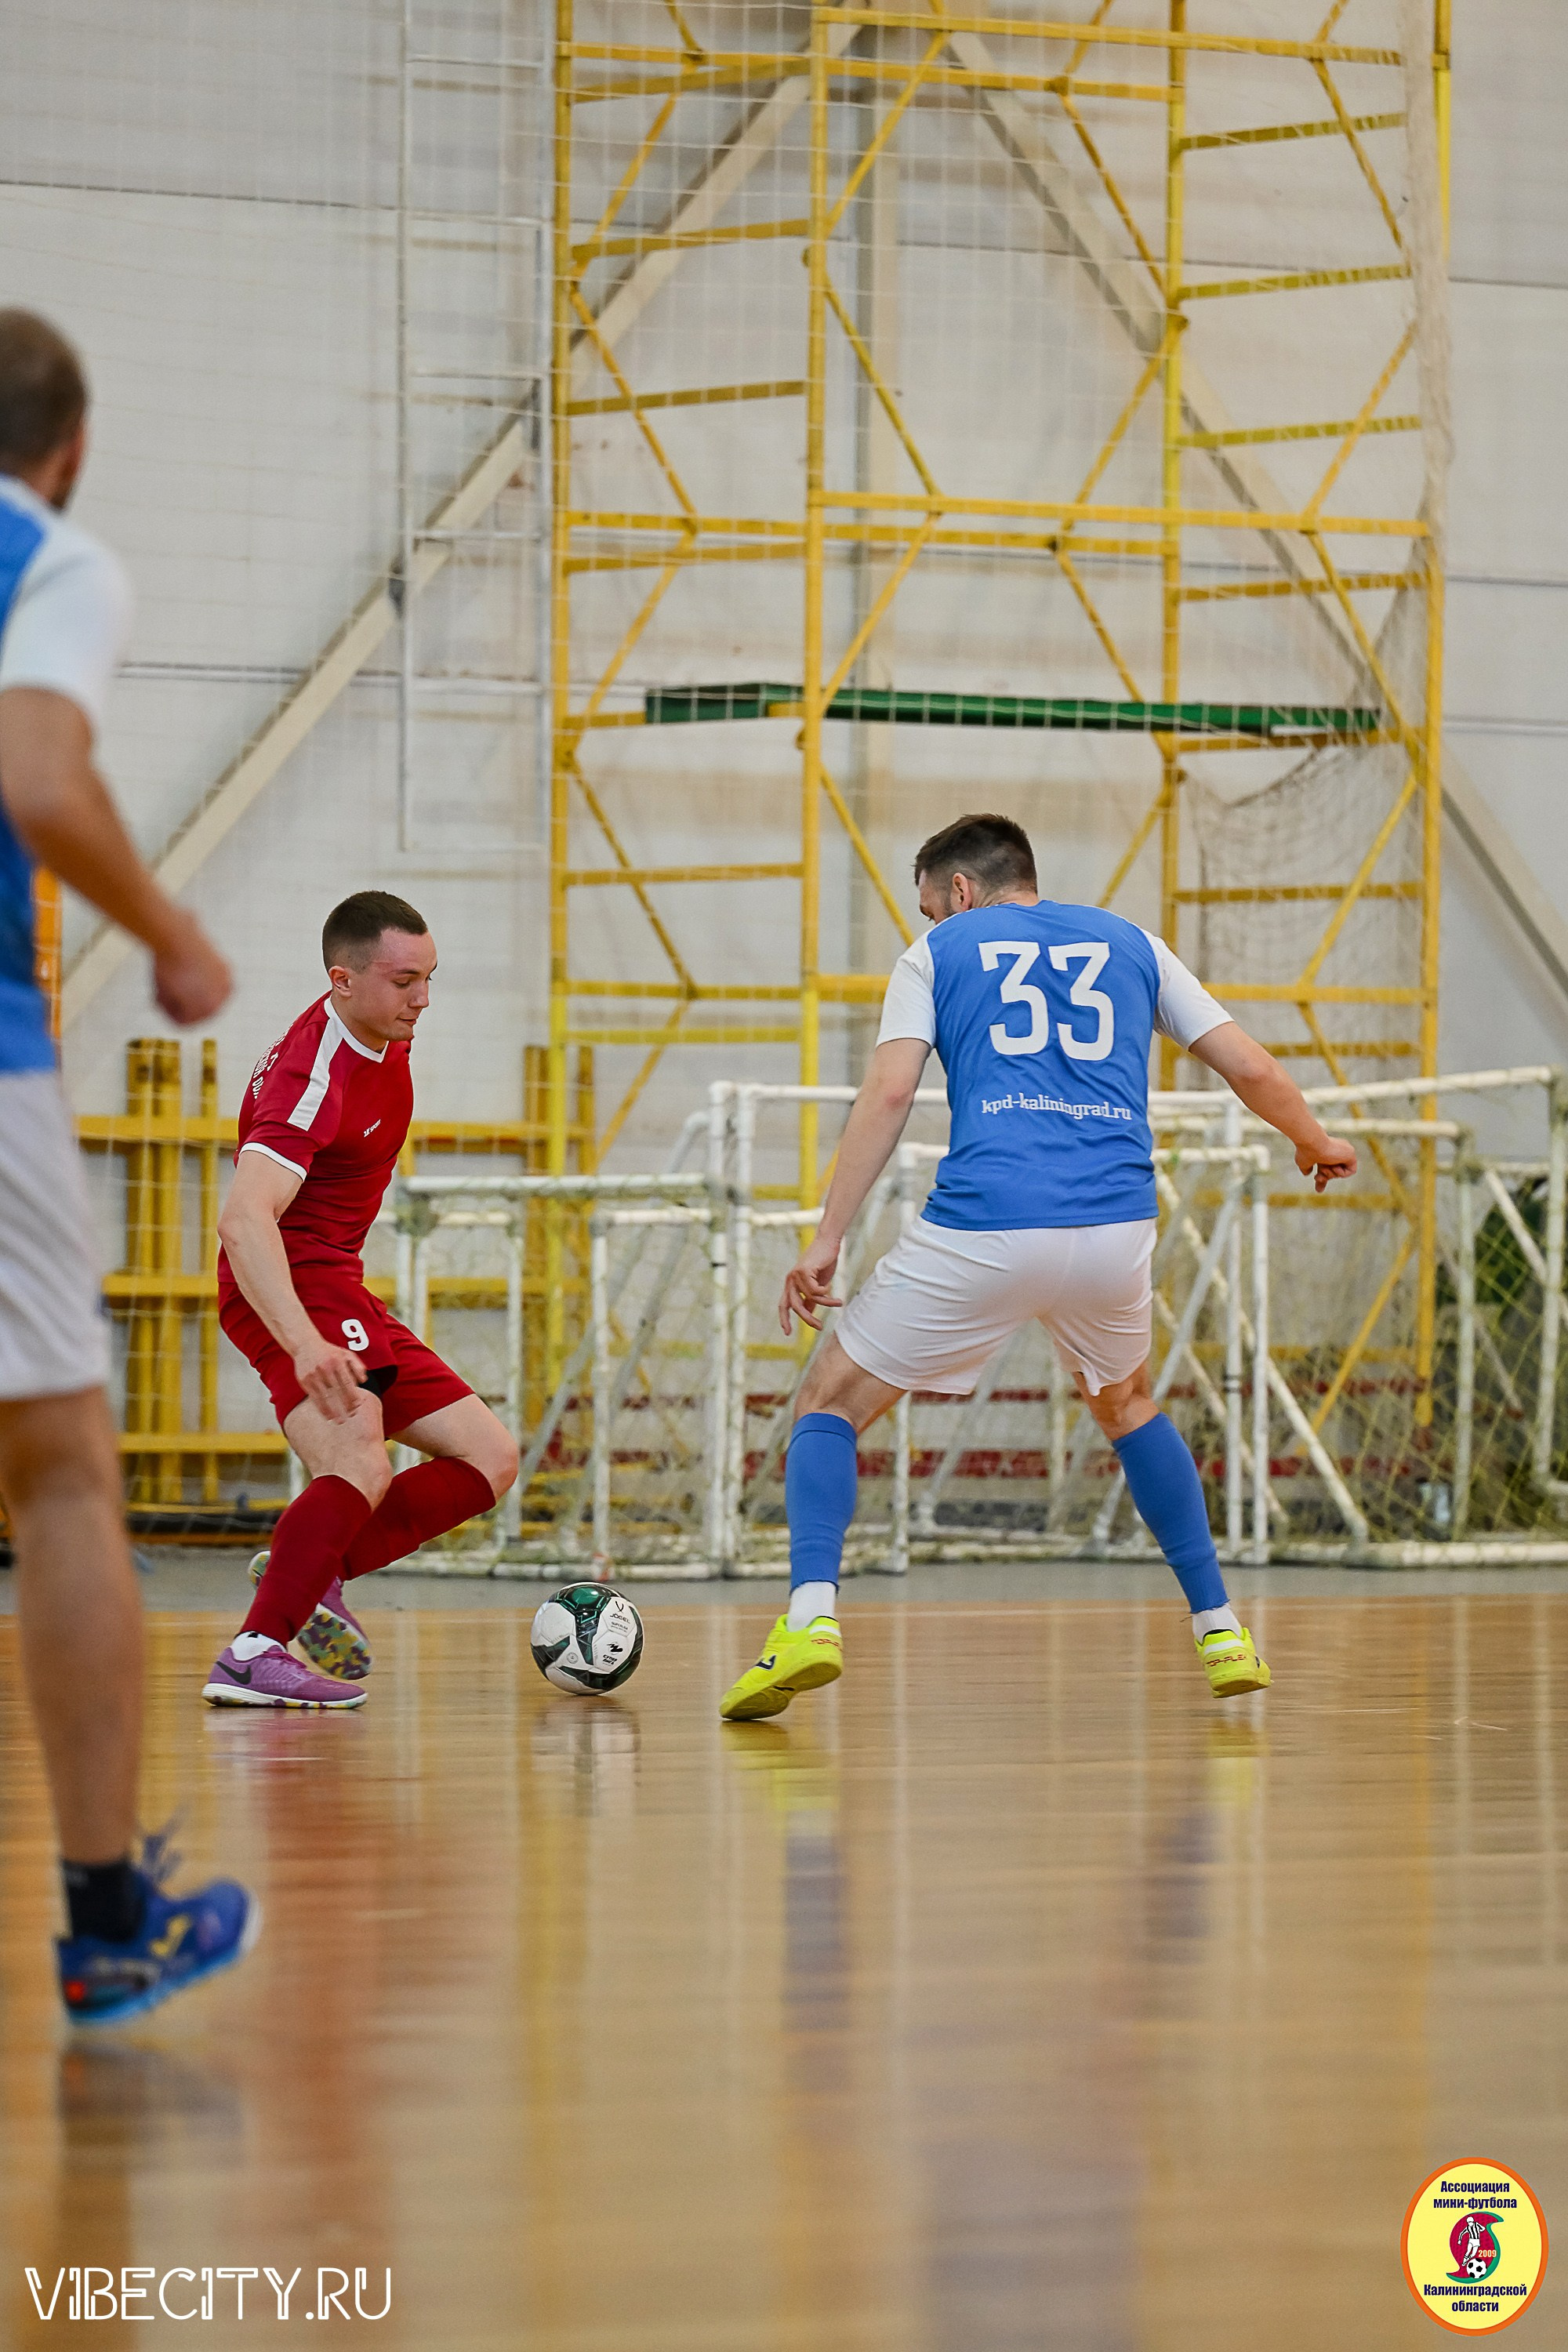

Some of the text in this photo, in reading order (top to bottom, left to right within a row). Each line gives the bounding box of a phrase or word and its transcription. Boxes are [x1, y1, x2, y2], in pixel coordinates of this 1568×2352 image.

[978, 941, 1114, 1062] 33
[981, 1092, 1132, 1120] kpd-kaliningrad.ru
[341, 1319, 369, 1352] 9
